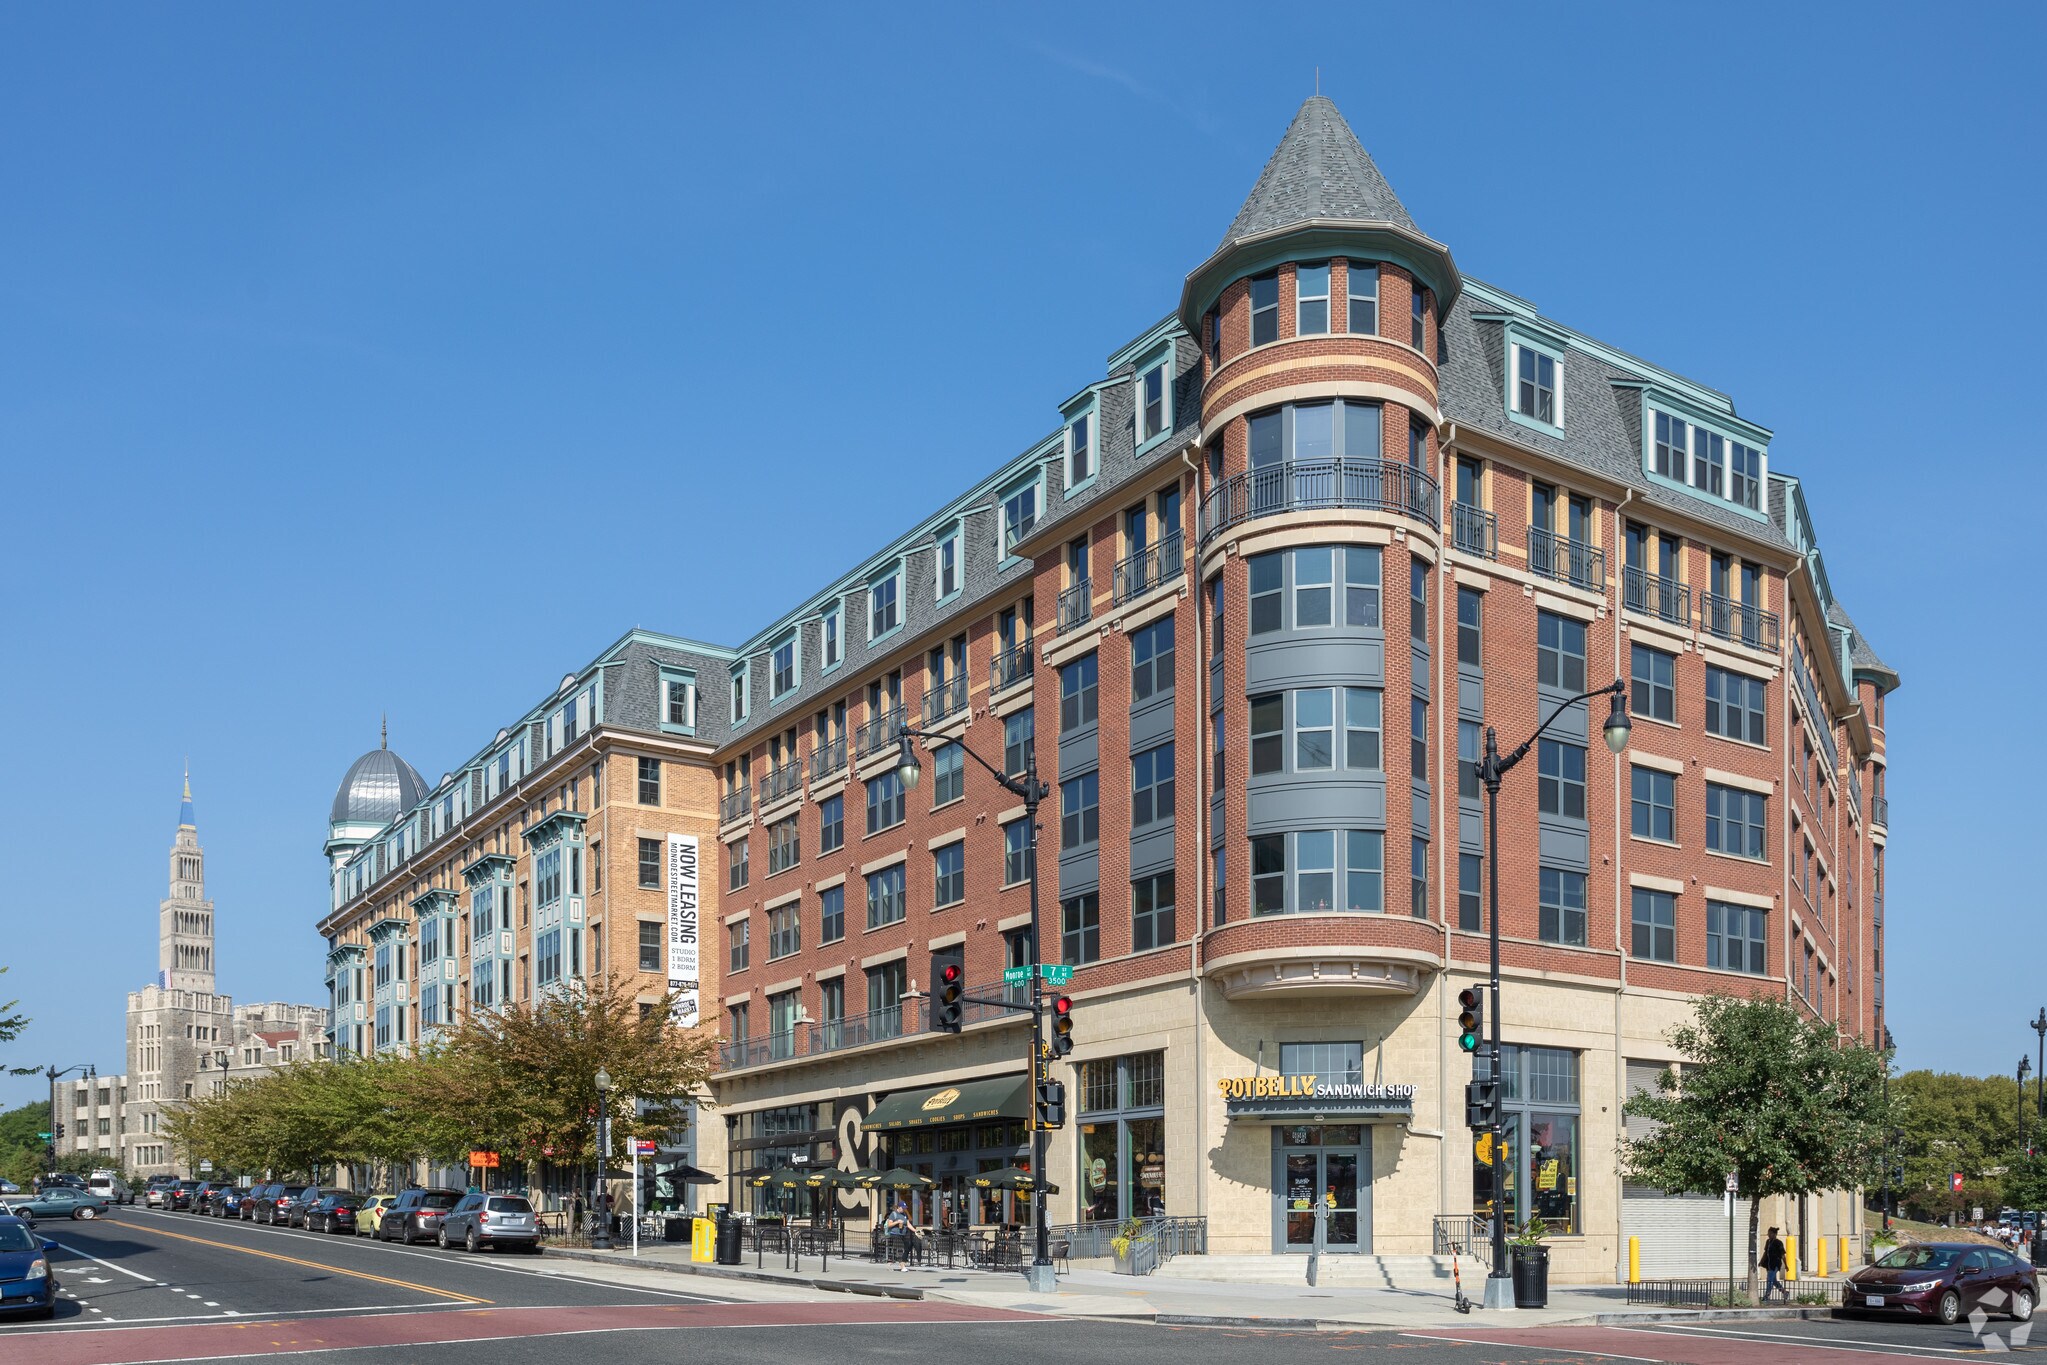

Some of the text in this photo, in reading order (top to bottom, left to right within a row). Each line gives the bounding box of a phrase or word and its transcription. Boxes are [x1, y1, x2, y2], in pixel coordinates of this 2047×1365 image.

[670, 842, 678, 943] MONROESTREETMARKET.COM
[680, 844, 696, 944] NOW LEASING
[671, 947, 696, 955] STUDIO
[677, 963, 696, 971] BDRM
[1050, 967, 1057, 976] 7
[1005, 970, 1024, 980] Monroe
[1217, 1075, 1418, 1098] POTBELLY SANDWICH SHOP
[973, 1109, 999, 1118] SANDWICHES
